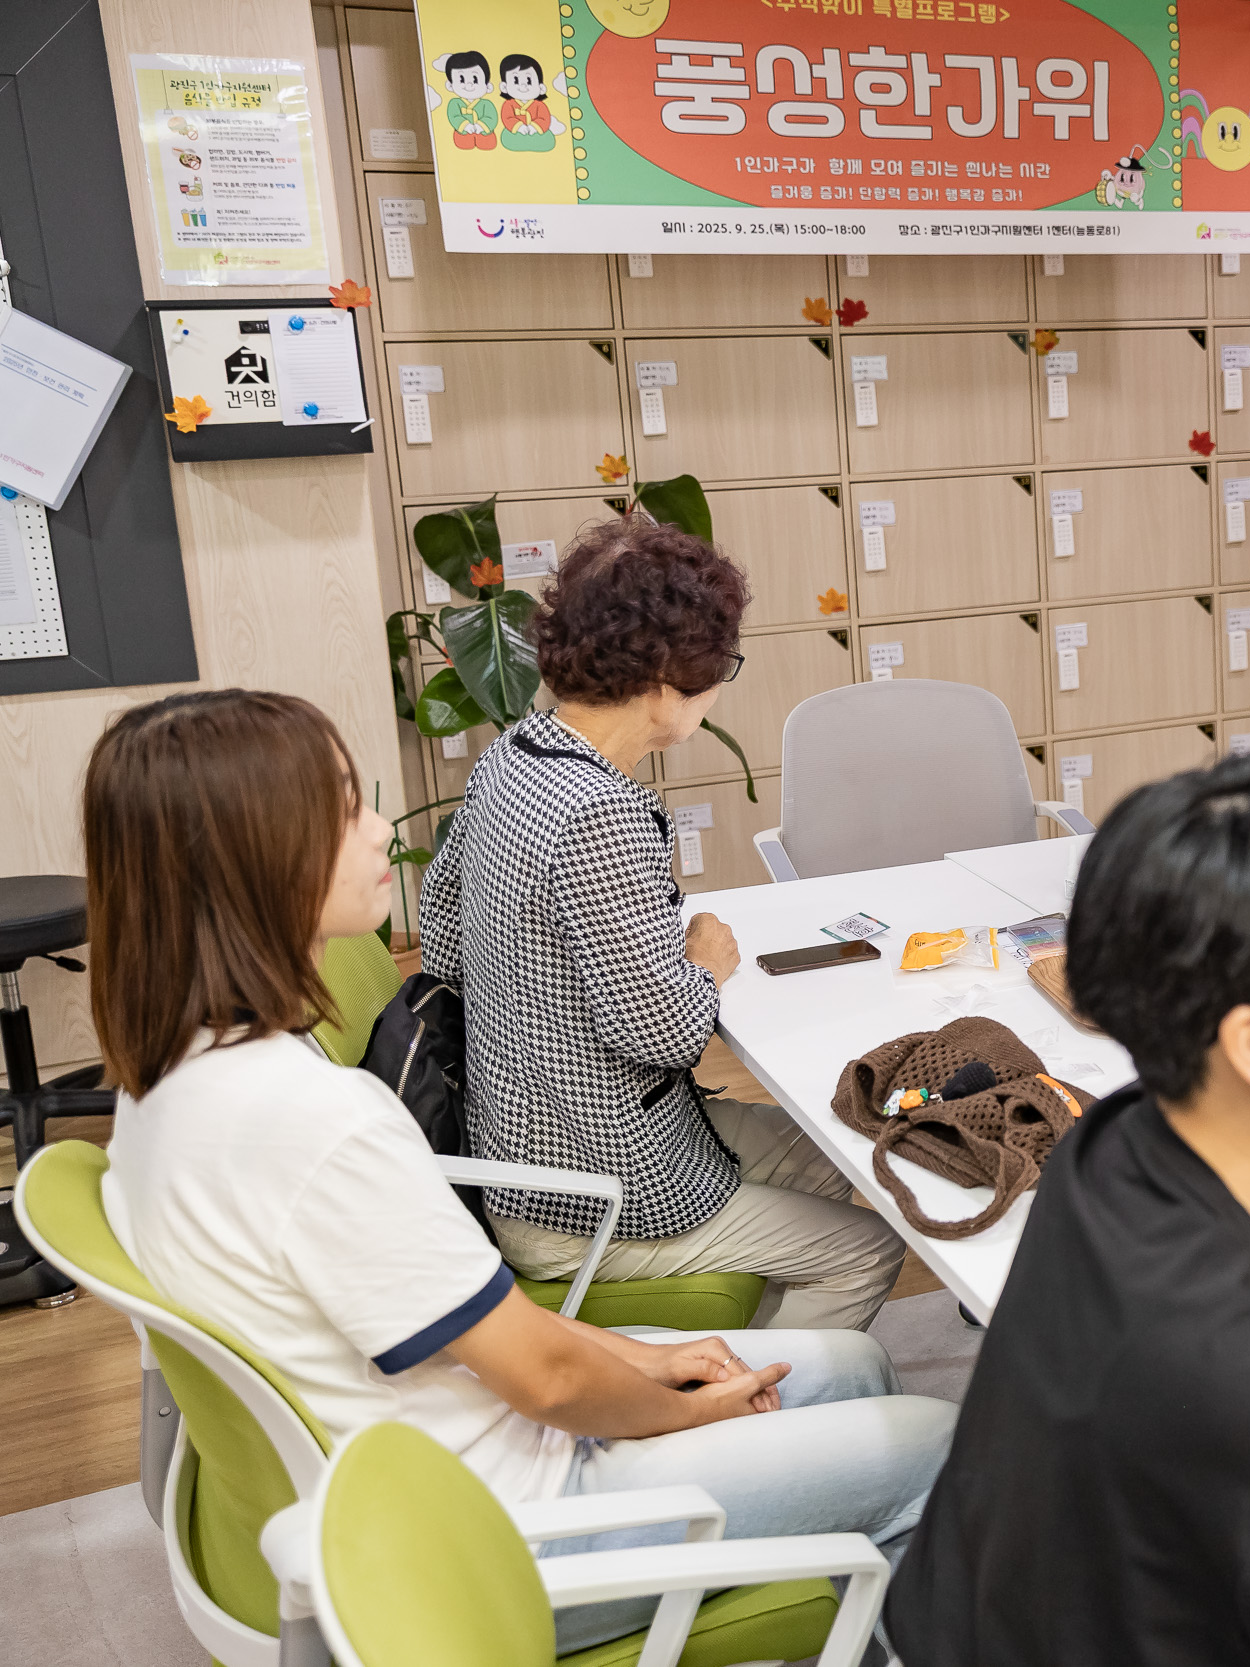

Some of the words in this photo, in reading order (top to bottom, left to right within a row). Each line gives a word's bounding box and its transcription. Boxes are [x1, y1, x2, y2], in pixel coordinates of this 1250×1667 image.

[653, 38, 1109, 142] 풍성한가위
[734, 157, 816, 174] 1인가구가
[829, 158, 863, 175] 함께
[870, 159, 903, 176] 모여
[910, 160, 958, 177] 즐기는
[1019, 162, 1051, 179] 시간
[771, 184, 814, 200] 즐거움
[819, 185, 853, 201] 증가!
[907, 187, 939, 203] 증가!
[992, 188, 1024, 203] 증가!
[661, 222, 686, 233] 일시
[697, 223, 732, 234] 2025.
[735, 223, 747, 234] 9.
[794, 224, 866, 235] 15:00~18:00
[899, 224, 921, 237] 장소
[224, 389, 277, 409] 건의함
